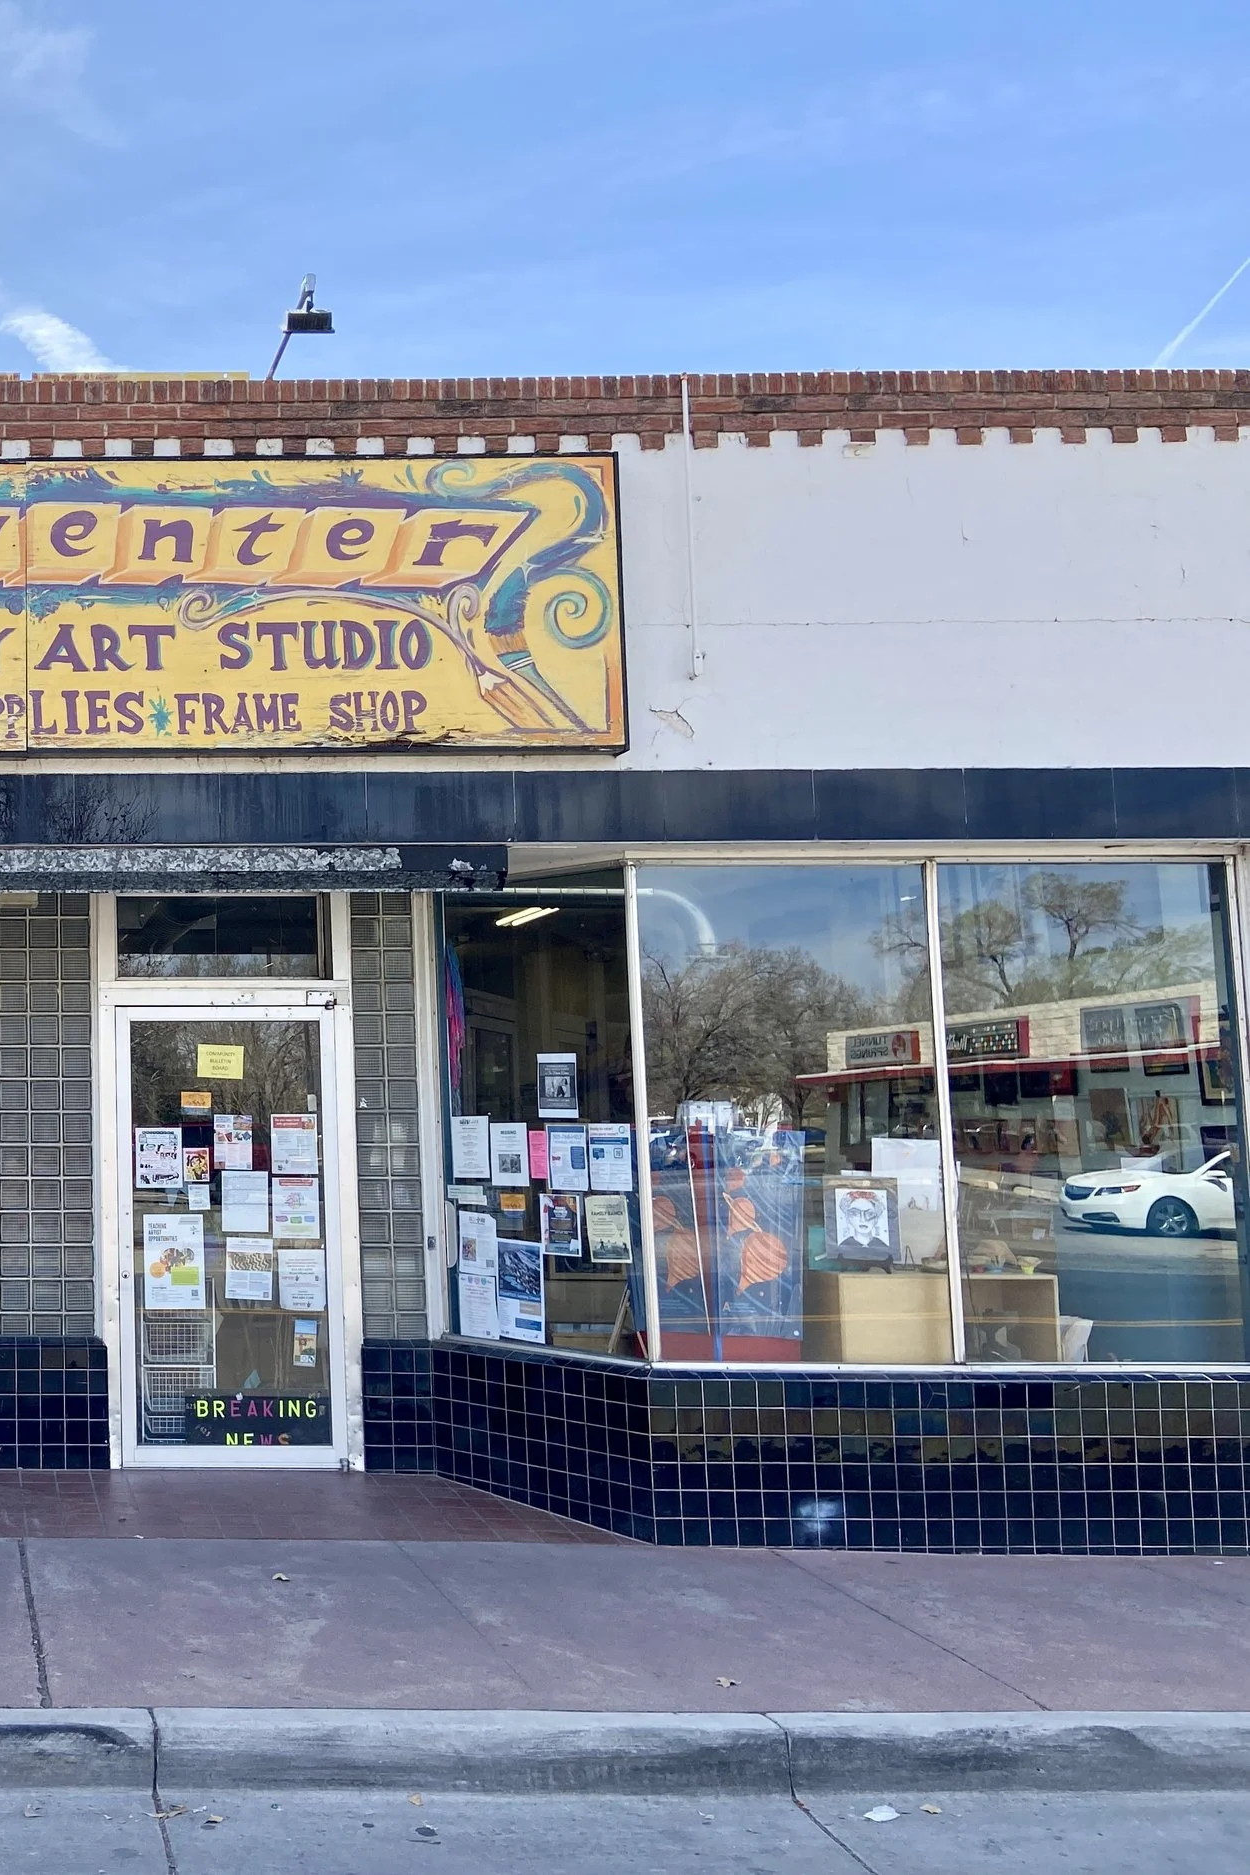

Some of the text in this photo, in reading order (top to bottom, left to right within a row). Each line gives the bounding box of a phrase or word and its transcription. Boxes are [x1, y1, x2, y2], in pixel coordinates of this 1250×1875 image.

[34, 622, 176, 672] ART
[220, 618, 432, 672] STUDIO
[176, 692, 303, 735] FRAME
[329, 690, 428, 733] SHOP
[196, 1399, 317, 1418] BREAKING
